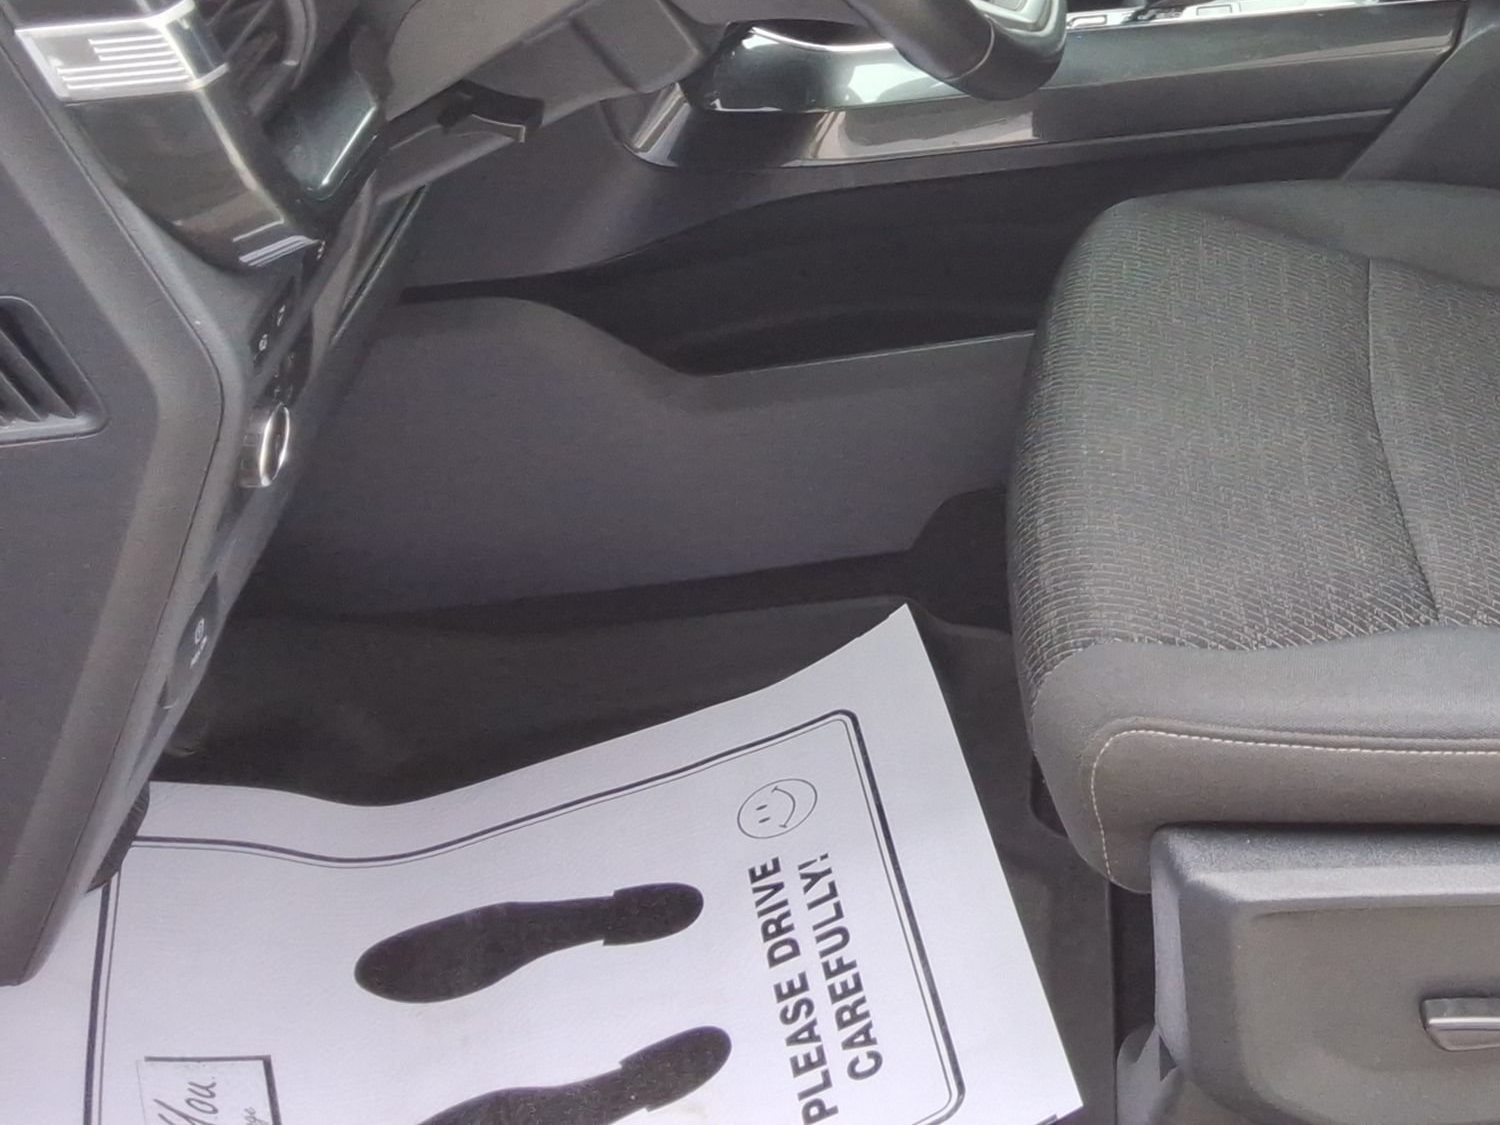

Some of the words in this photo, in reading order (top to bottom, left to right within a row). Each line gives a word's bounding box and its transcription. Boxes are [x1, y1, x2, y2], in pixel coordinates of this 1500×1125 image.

[747, 856, 801, 969] DRIVE
[797, 852, 884, 1081] CAREFULLY!
[773, 971, 839, 1125] PLEASE
